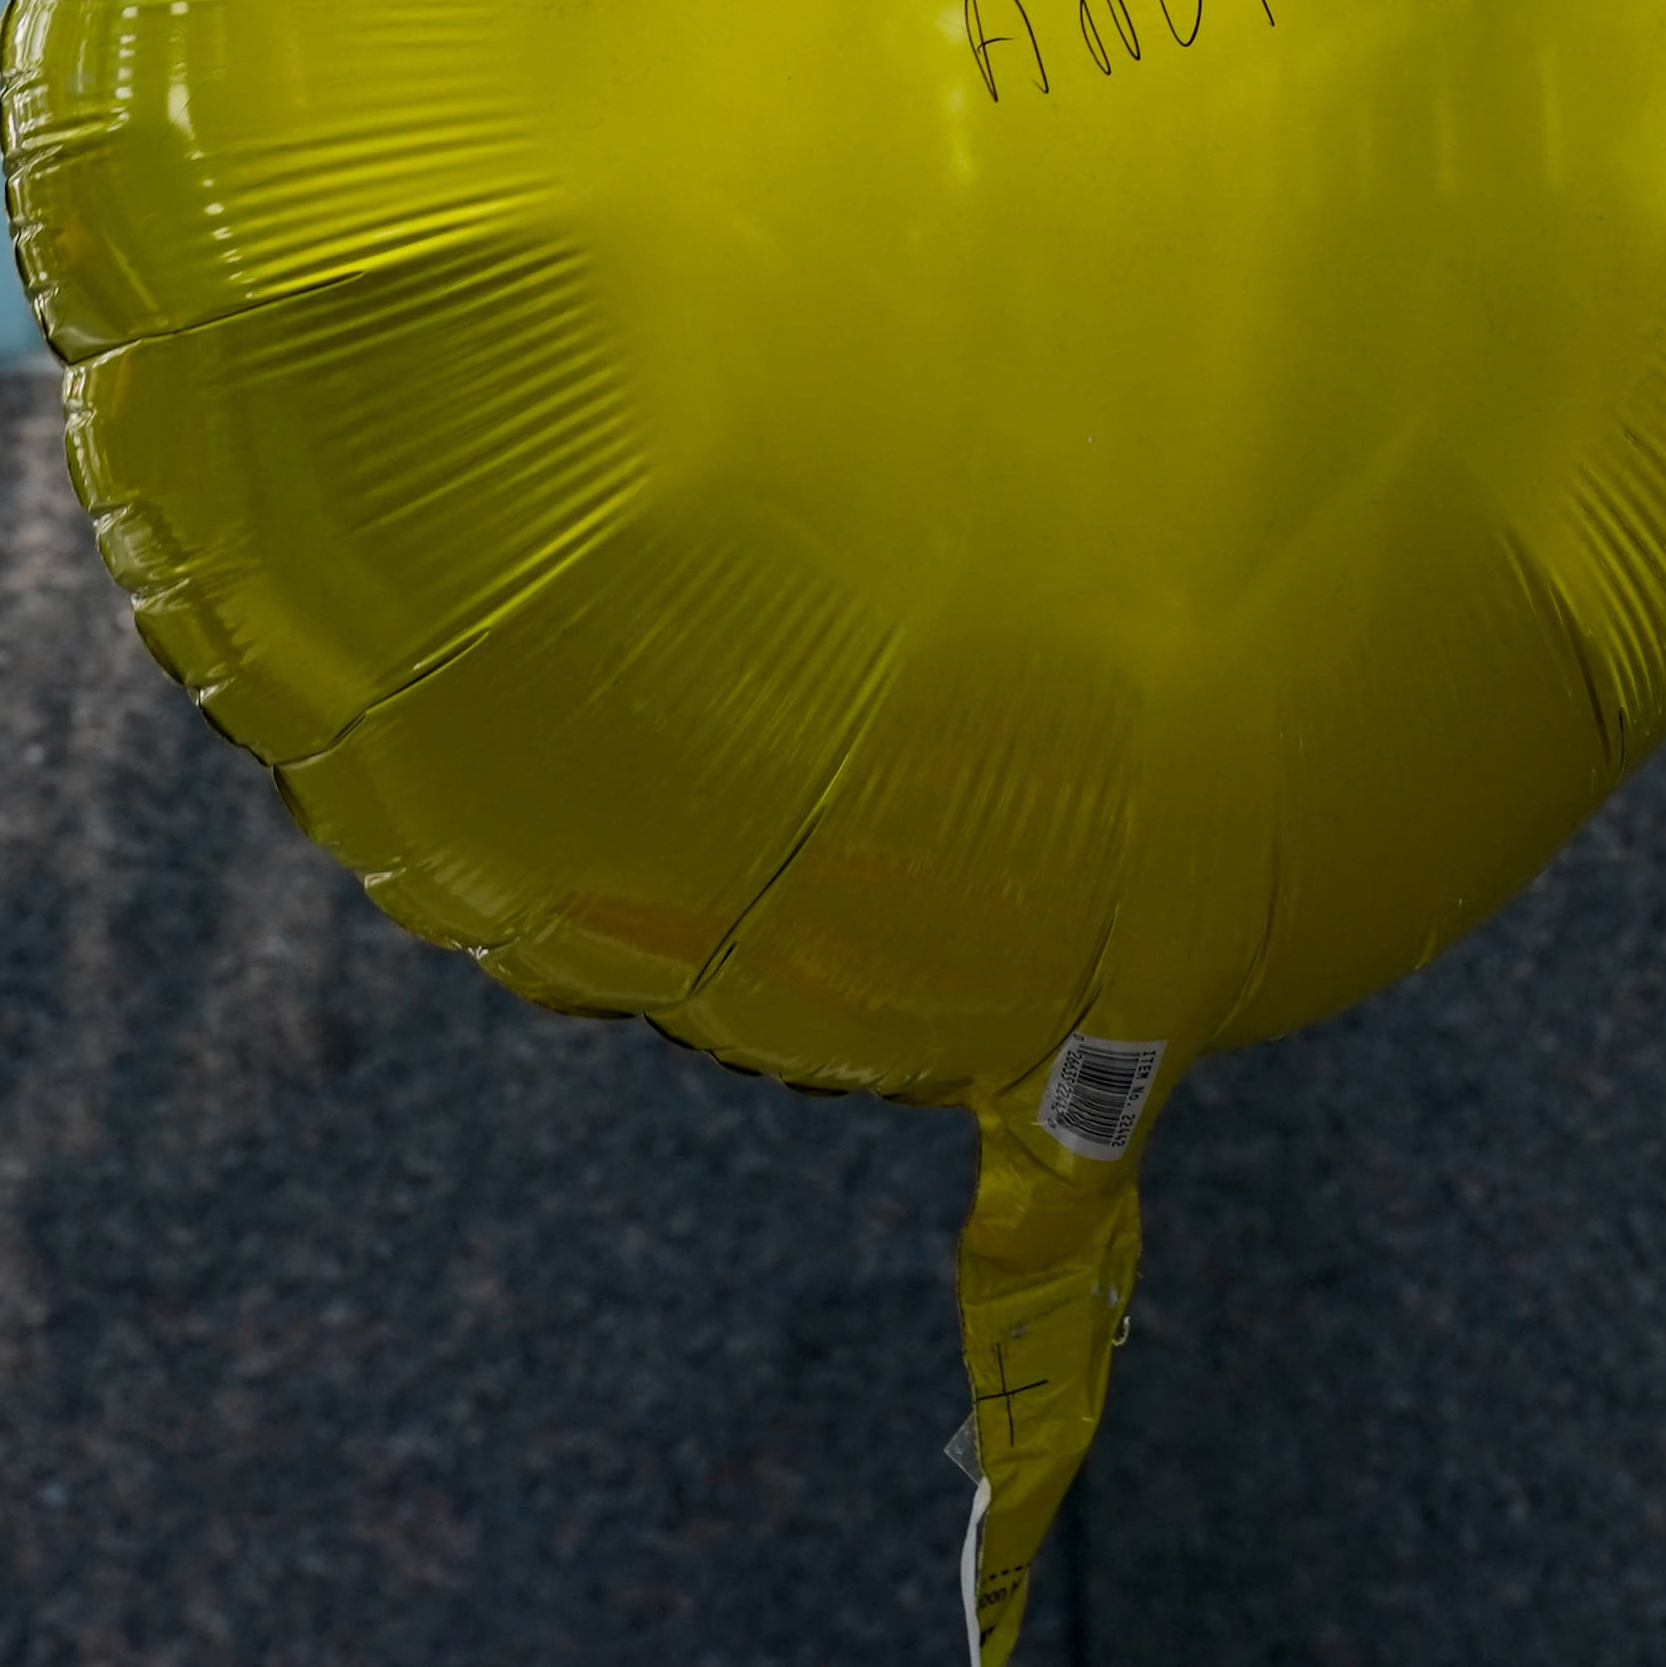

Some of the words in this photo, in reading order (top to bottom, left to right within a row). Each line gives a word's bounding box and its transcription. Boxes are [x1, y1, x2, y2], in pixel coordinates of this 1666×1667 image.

[1061, 1050, 1082, 1083] 26635
[1136, 1051, 1156, 1080] ITEM
[1112, 1114, 1135, 1147] 22442
